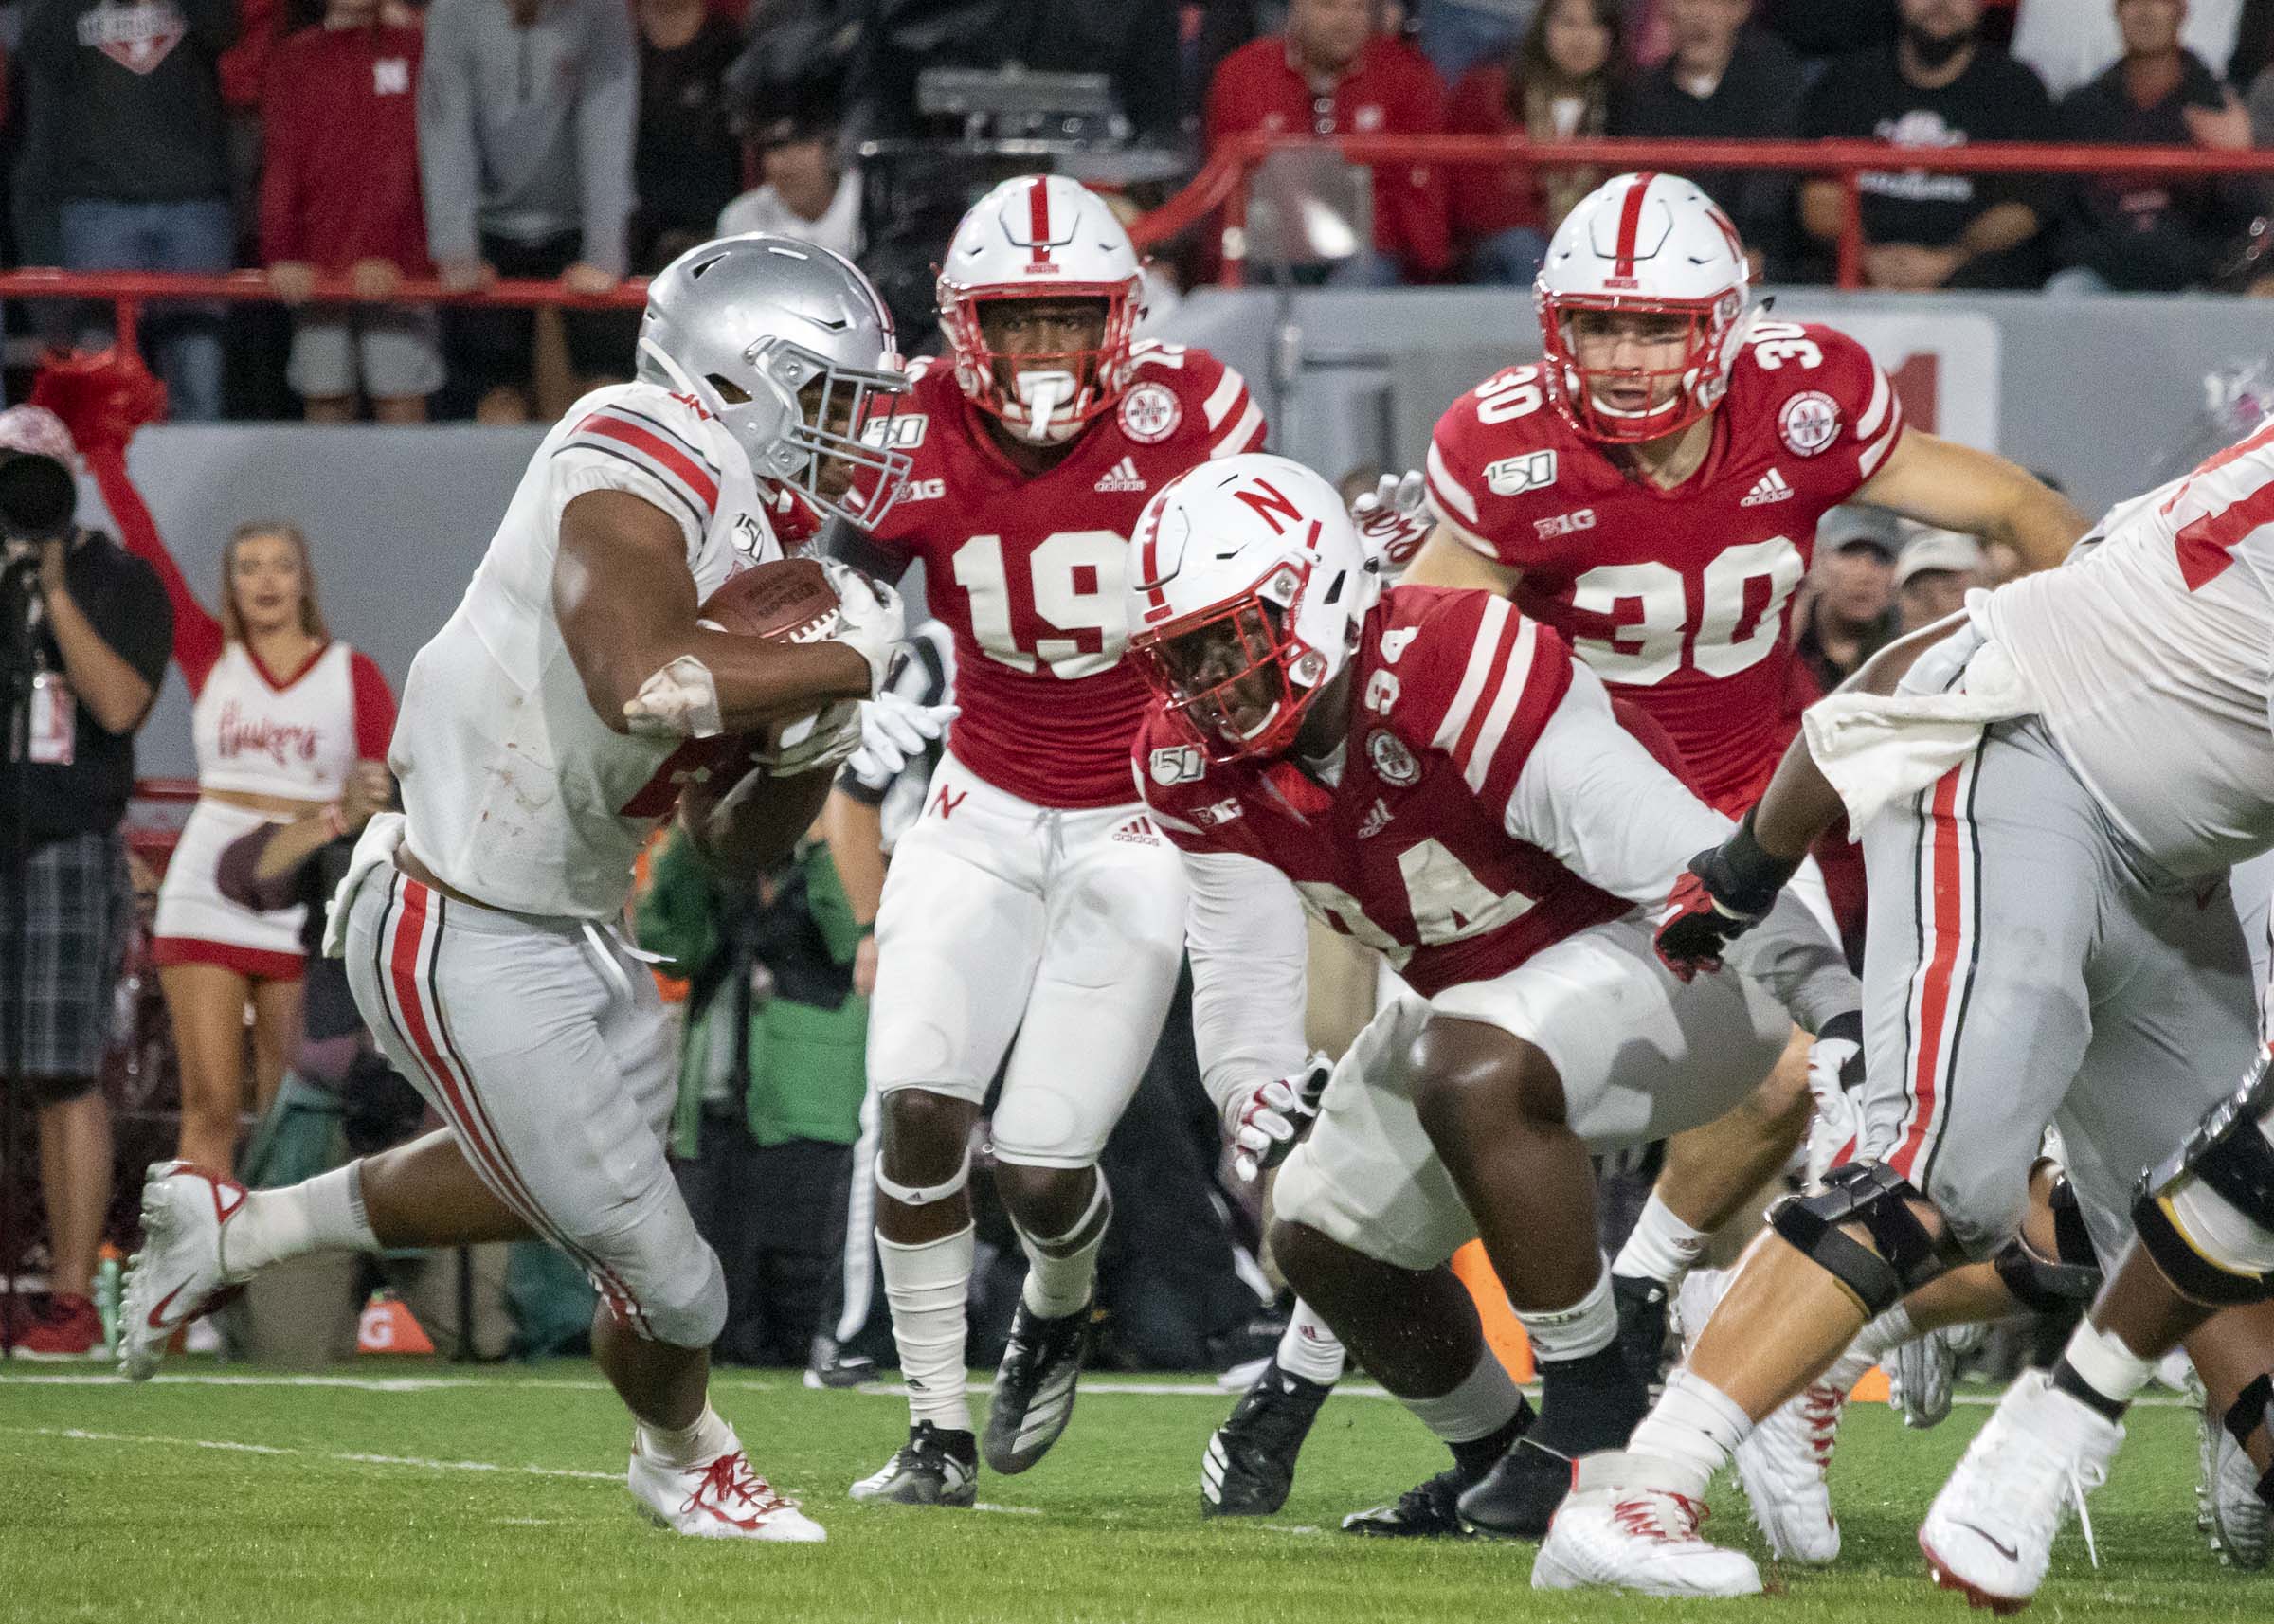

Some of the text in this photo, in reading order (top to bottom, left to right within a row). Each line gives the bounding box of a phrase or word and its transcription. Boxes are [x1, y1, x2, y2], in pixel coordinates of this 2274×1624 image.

[1094, 477, 1146, 492] adidas
[1482, 450, 1558, 496] 150
[1234, 478, 1304, 536] N
[952, 530, 1129, 680] 19
[1572, 534, 1805, 686] 30
[929, 784, 967, 820] N
[359, 1308, 395, 1349] G
